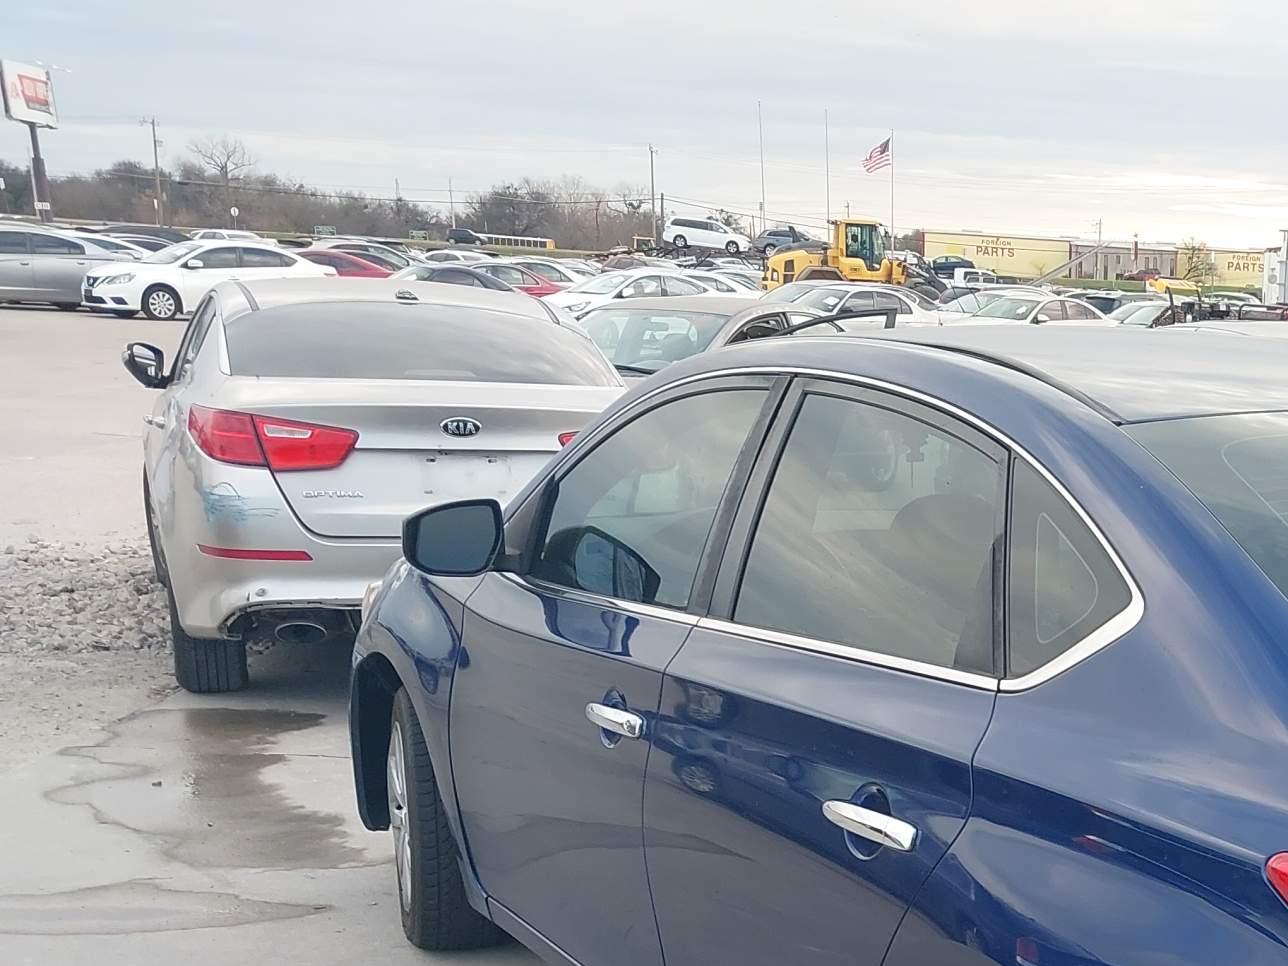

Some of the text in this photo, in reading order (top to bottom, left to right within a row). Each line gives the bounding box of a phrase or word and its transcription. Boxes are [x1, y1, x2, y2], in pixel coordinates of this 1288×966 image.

[976, 246, 1015, 258] PARTS
[1227, 261, 1265, 273] PARTS
[446, 421, 477, 435] KIA
[302, 489, 364, 499] OPTIMA
